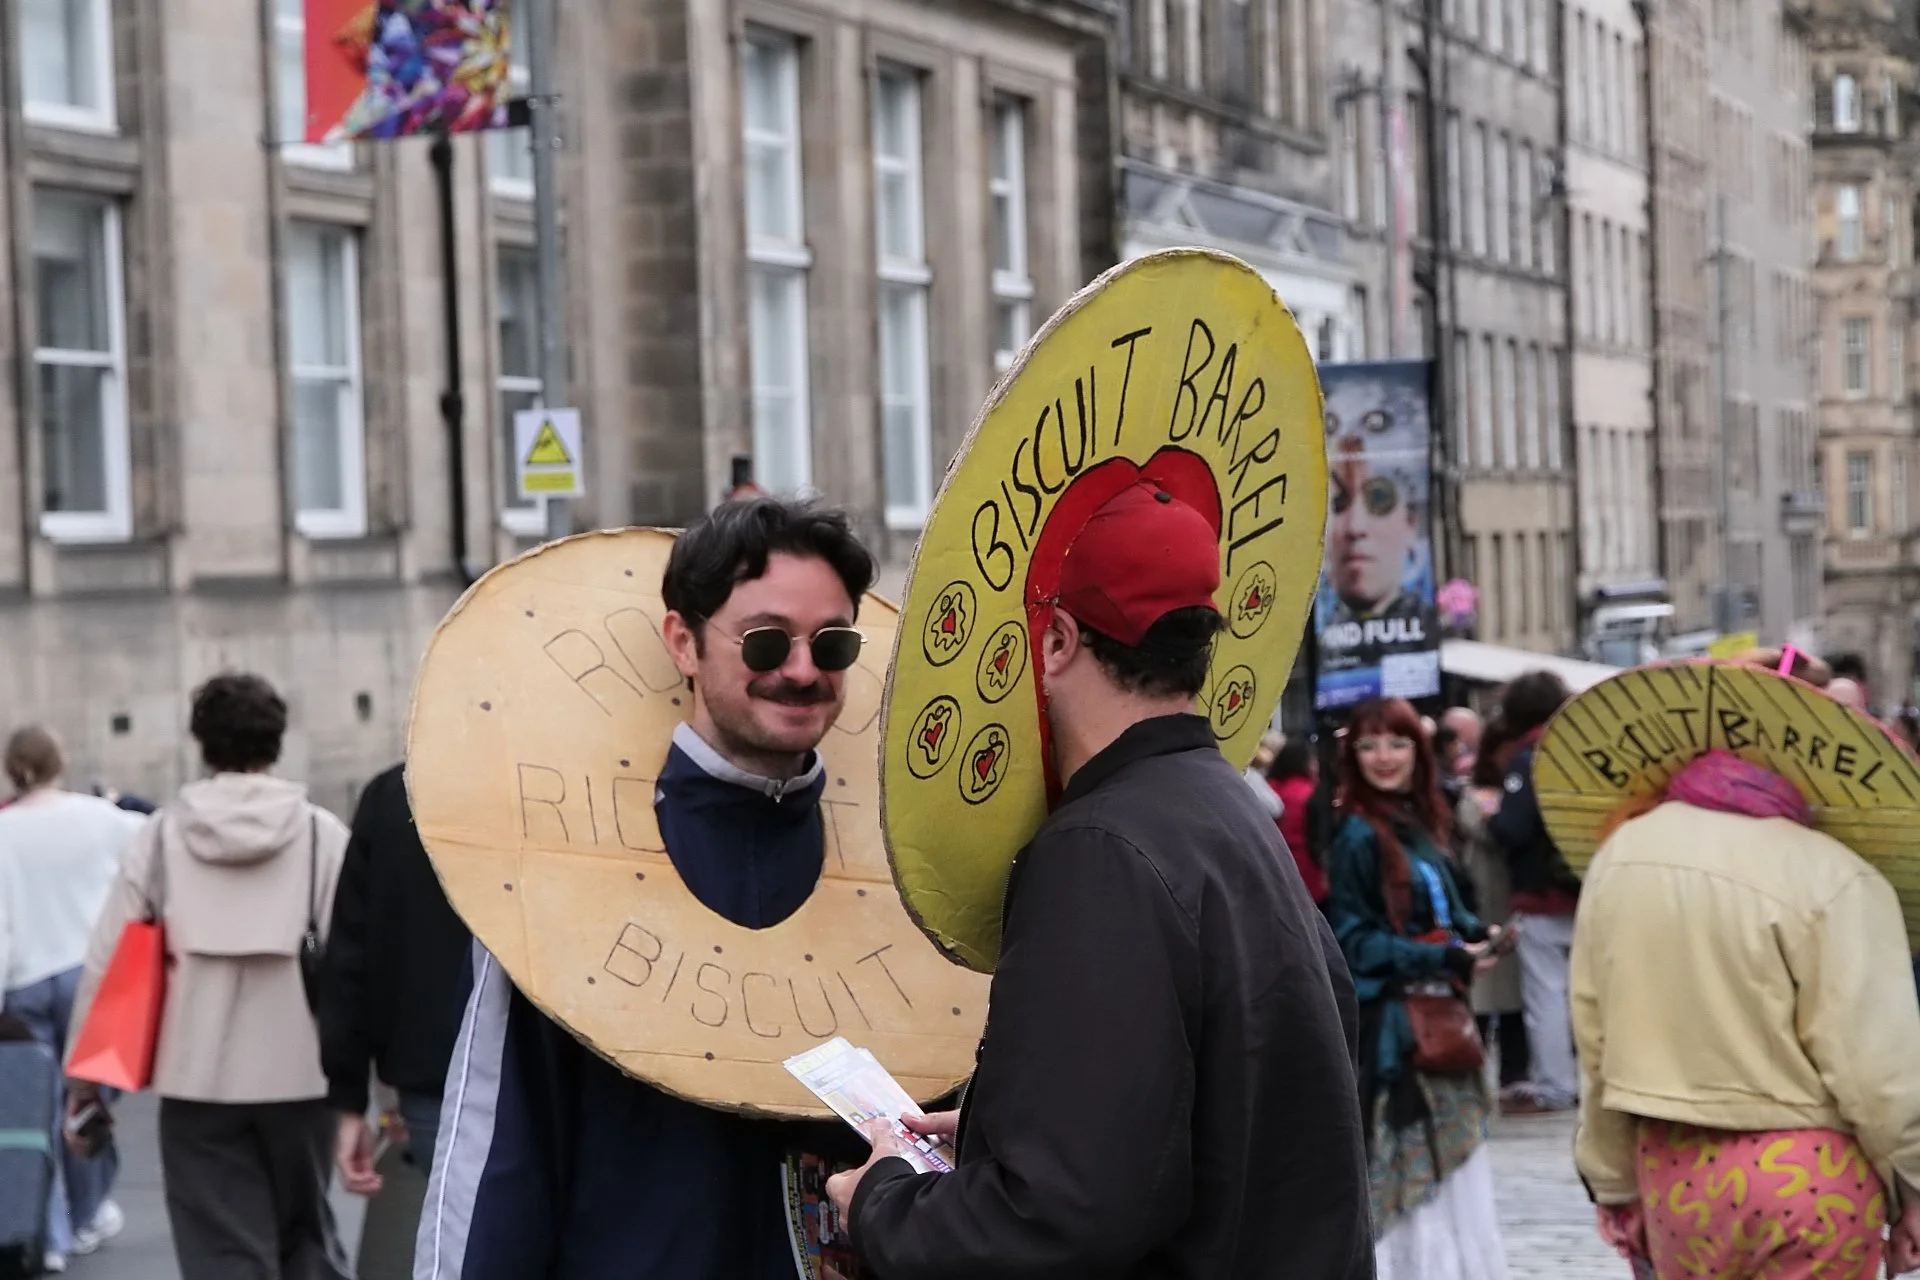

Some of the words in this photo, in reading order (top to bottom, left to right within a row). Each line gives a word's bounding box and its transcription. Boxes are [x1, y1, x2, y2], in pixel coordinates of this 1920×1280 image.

[971, 326, 1152, 592] BISCUIT
[1168, 317, 1288, 577] BARREL
[1718, 708, 1883, 794] BARREL
[603, 922, 915, 1039] BISCUIT
